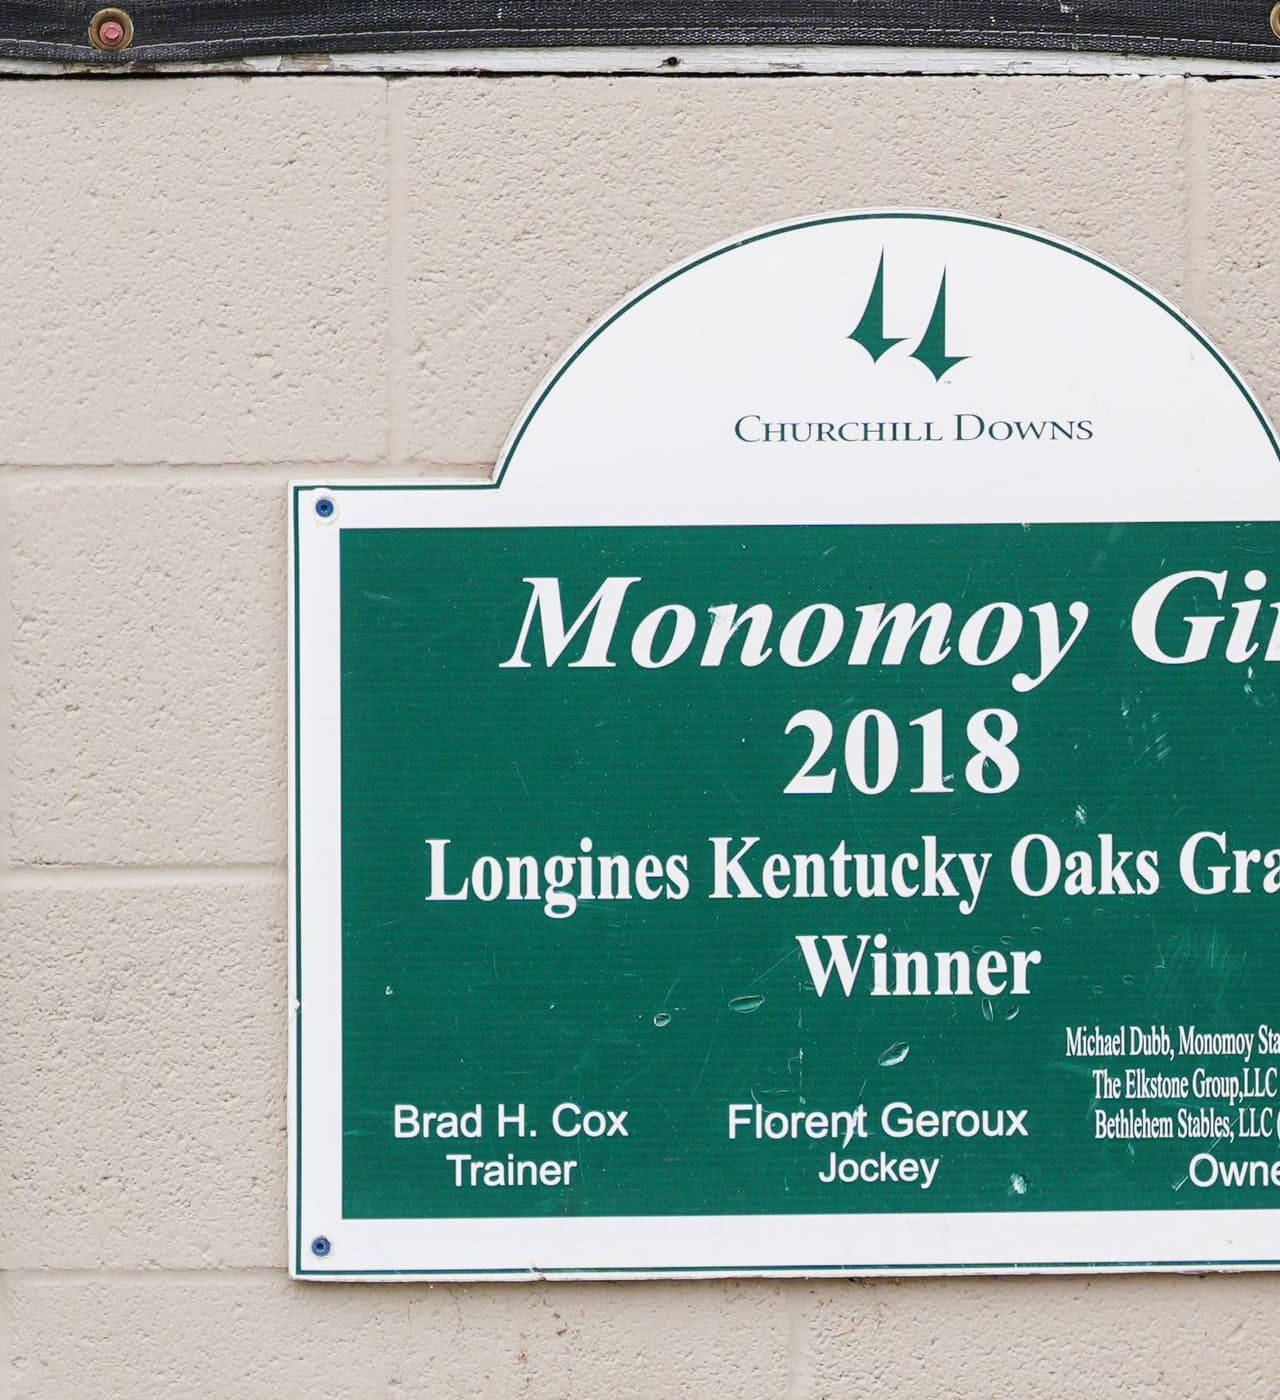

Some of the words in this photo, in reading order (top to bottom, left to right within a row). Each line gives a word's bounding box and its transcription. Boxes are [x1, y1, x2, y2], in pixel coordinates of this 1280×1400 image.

[498, 576, 1089, 692] Monomoy
[783, 708, 1020, 795] 2018
[424, 836, 690, 919] Longines
[708, 835, 993, 915] Kentucky
[1010, 833, 1160, 897] Oaks
[795, 933, 1042, 998] Winner
[1065, 1025, 1126, 1057] Michael
[1129, 1025, 1175, 1061] Dubb,
[1178, 1025, 1255, 1063] Monomoy
[1092, 1068, 1122, 1099] The
[1125, 1068, 1189, 1099] Elkstone
[394, 1103, 482, 1139] Brad
[497, 1103, 537, 1138] H.
[552, 1102, 629, 1138] Cox
[728, 1103, 868, 1140] Florent
[881, 1101, 1029, 1138] Geroux
[1094, 1107, 1174, 1139] Bethlehem
[1177, 1107, 1235, 1143] Stables,
[1238, 1107, 1273, 1138] LLC
[445, 1153, 578, 1187] Trainer
[818, 1151, 940, 1189] Jockey
